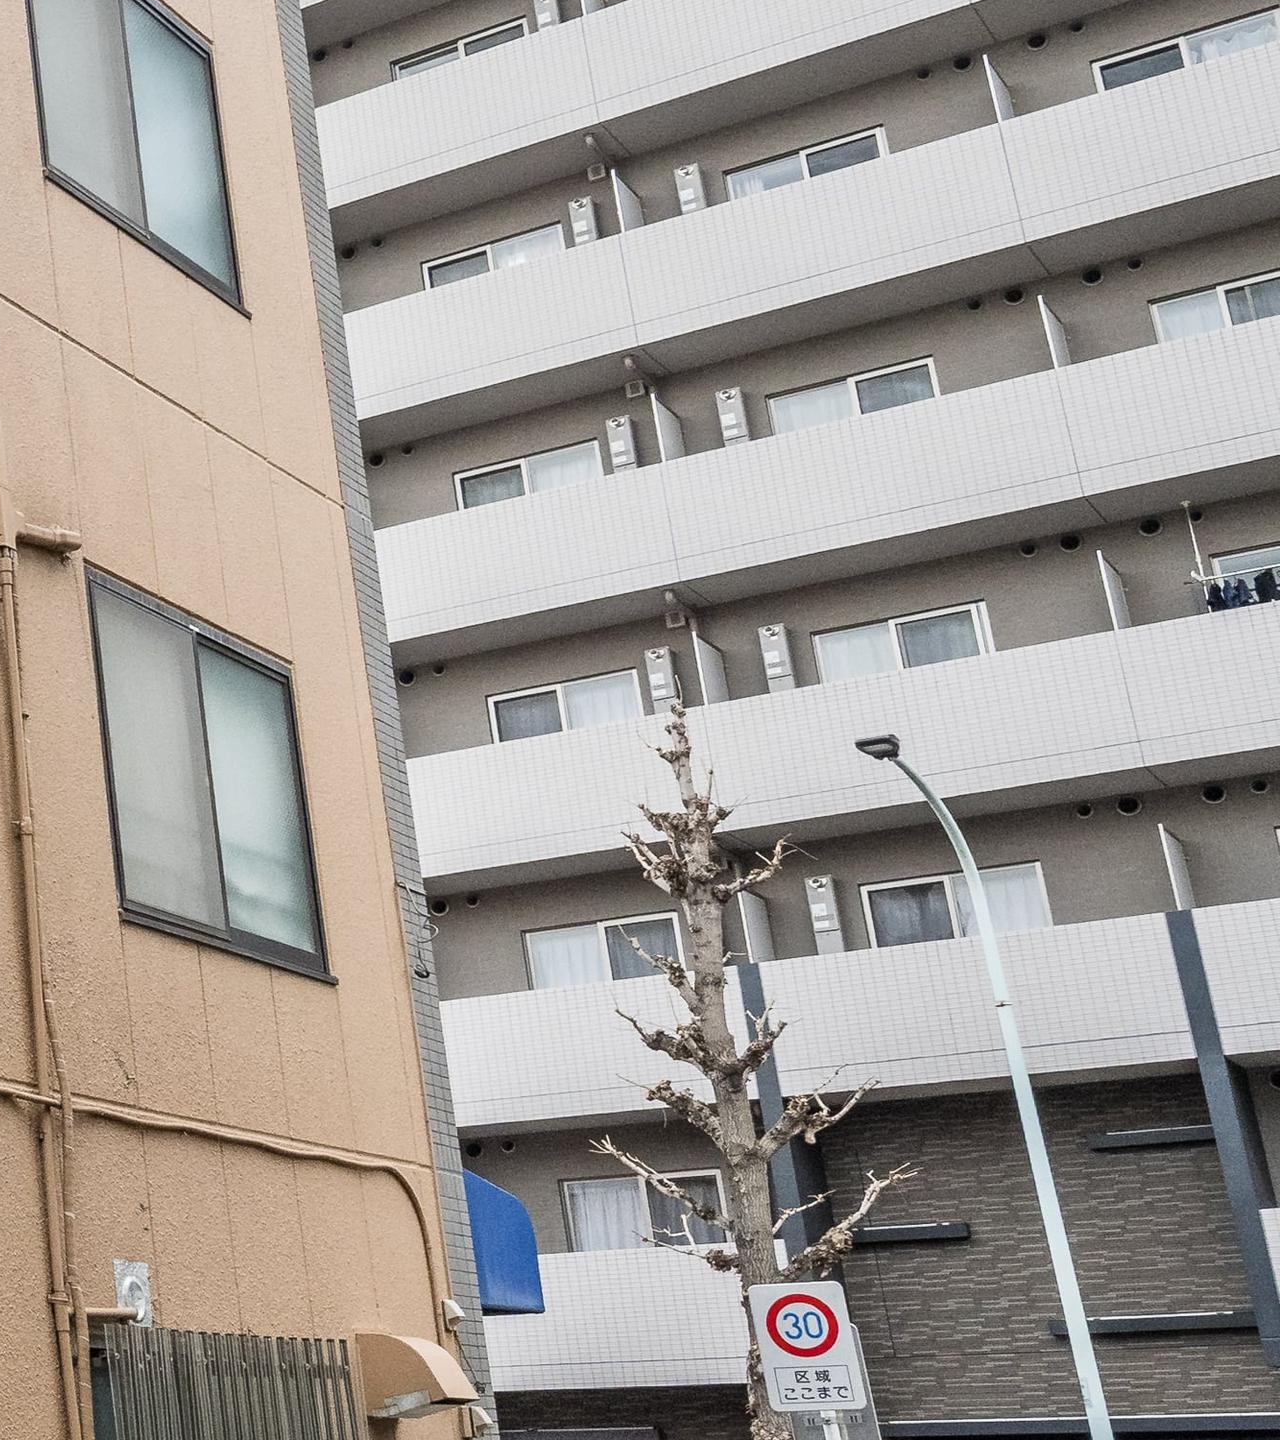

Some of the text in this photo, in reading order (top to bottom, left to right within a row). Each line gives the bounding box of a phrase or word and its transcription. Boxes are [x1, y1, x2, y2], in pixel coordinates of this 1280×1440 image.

[782, 1311, 824, 1340] 30
[794, 1370, 832, 1384] 区域
[784, 1386, 849, 1400] ここまで
